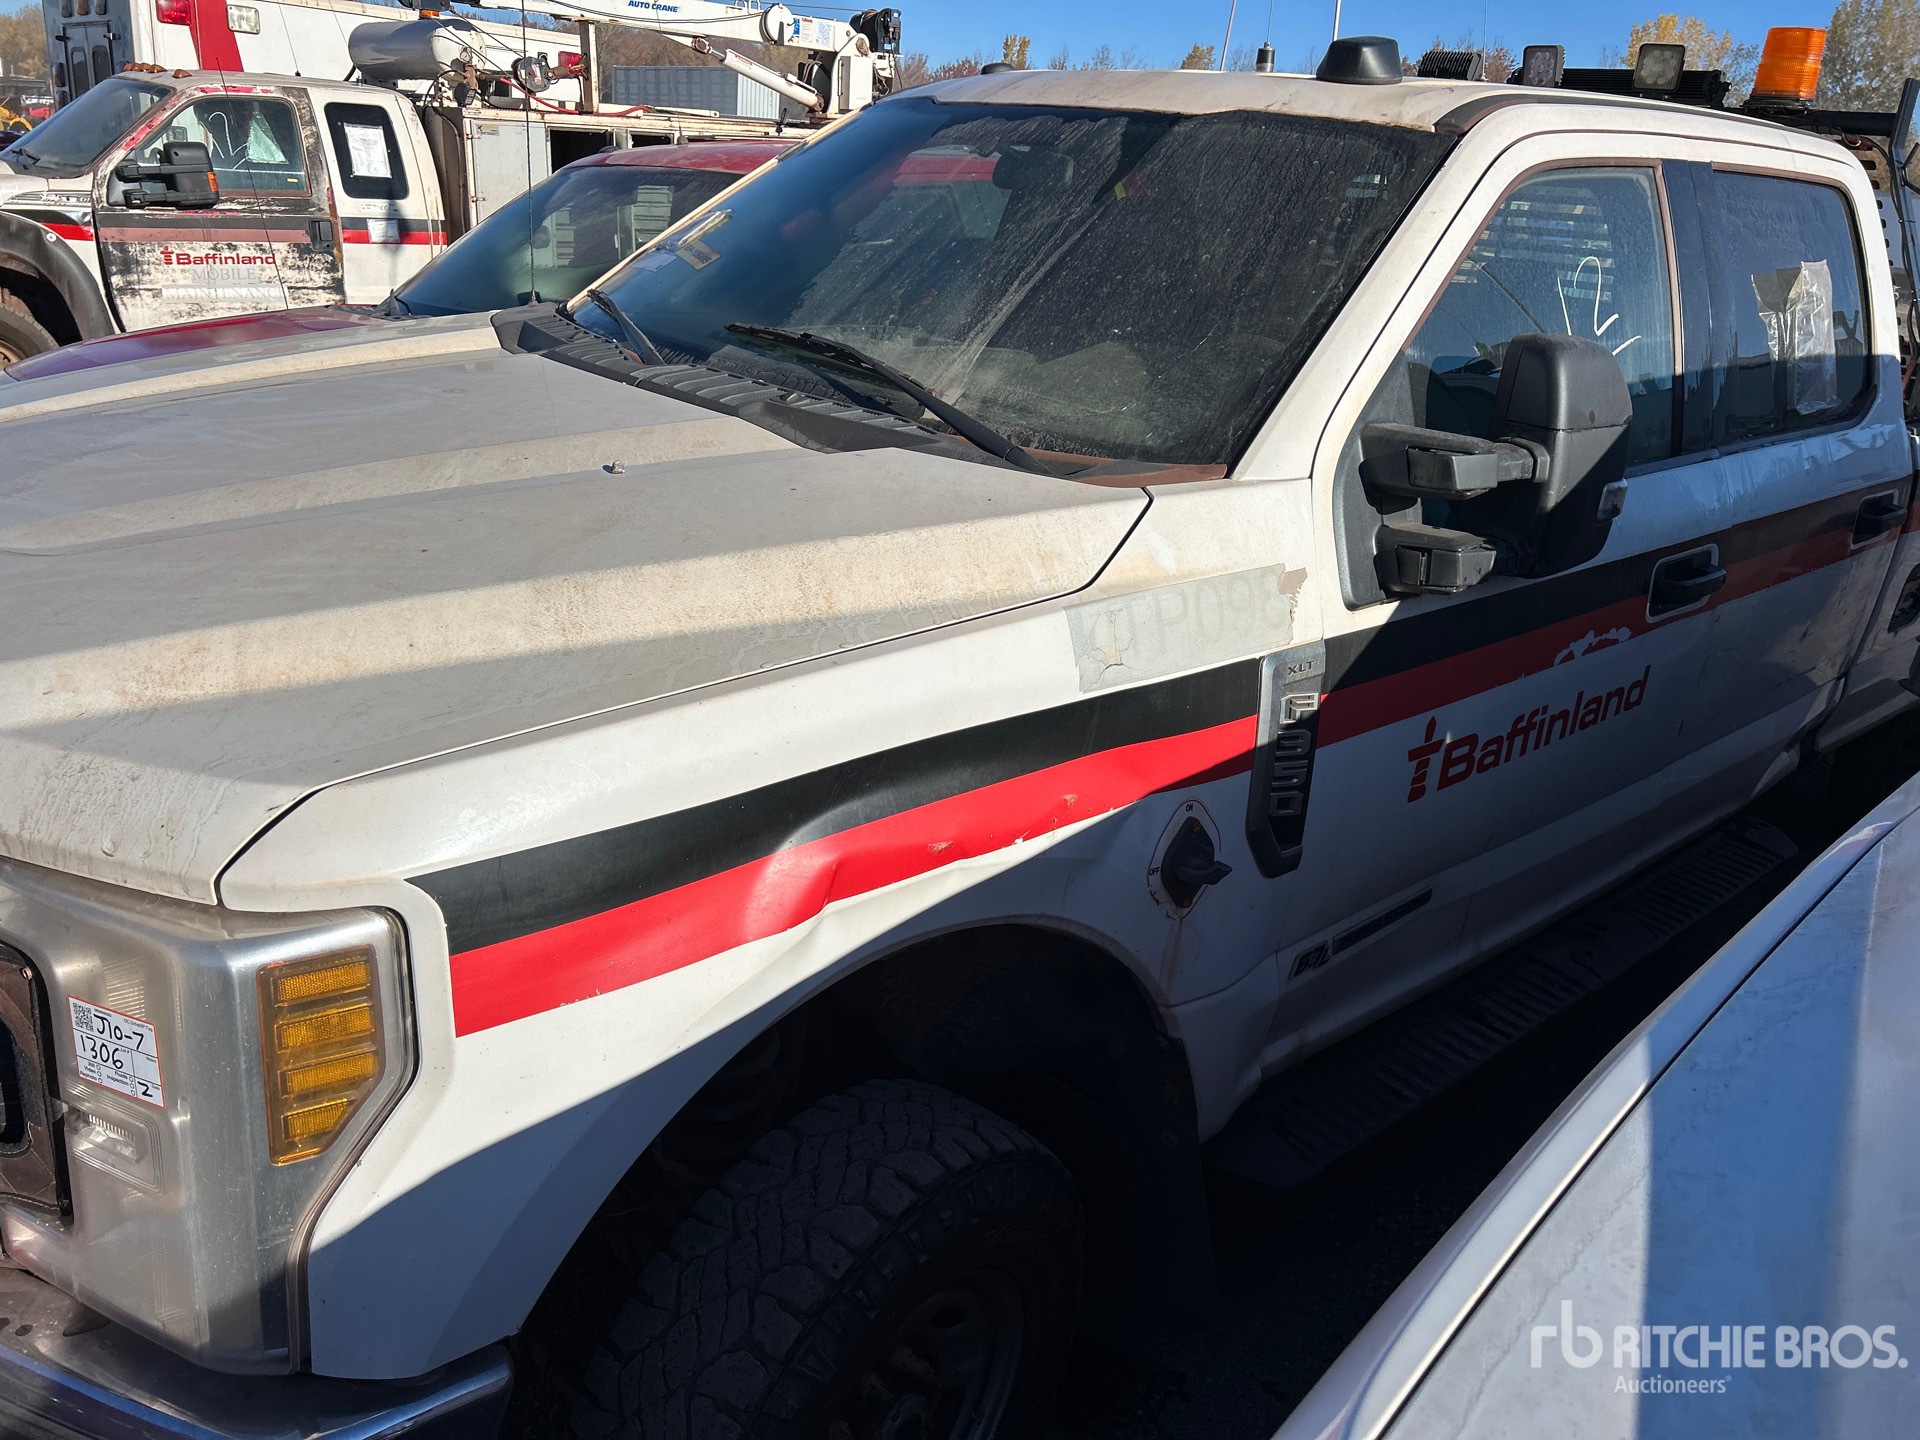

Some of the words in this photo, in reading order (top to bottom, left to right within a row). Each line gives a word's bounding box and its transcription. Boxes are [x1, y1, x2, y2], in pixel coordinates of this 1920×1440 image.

[628, 0, 650, 9] AUTO
[651, 3, 679, 13] CRANE
[176, 252, 276, 265] Baffinland
[193, 267, 257, 281] MOBILE
[1287, 659, 1317, 675] XLT
[1436, 664, 1652, 791] Baffinland
[1185, 803, 1194, 812] ON
[1149, 866, 1160, 876] OFF
[80, 1034, 124, 1070] 1306
[106, 1075, 129, 1086] Inspection
[137, 1081, 153, 1097] 2
